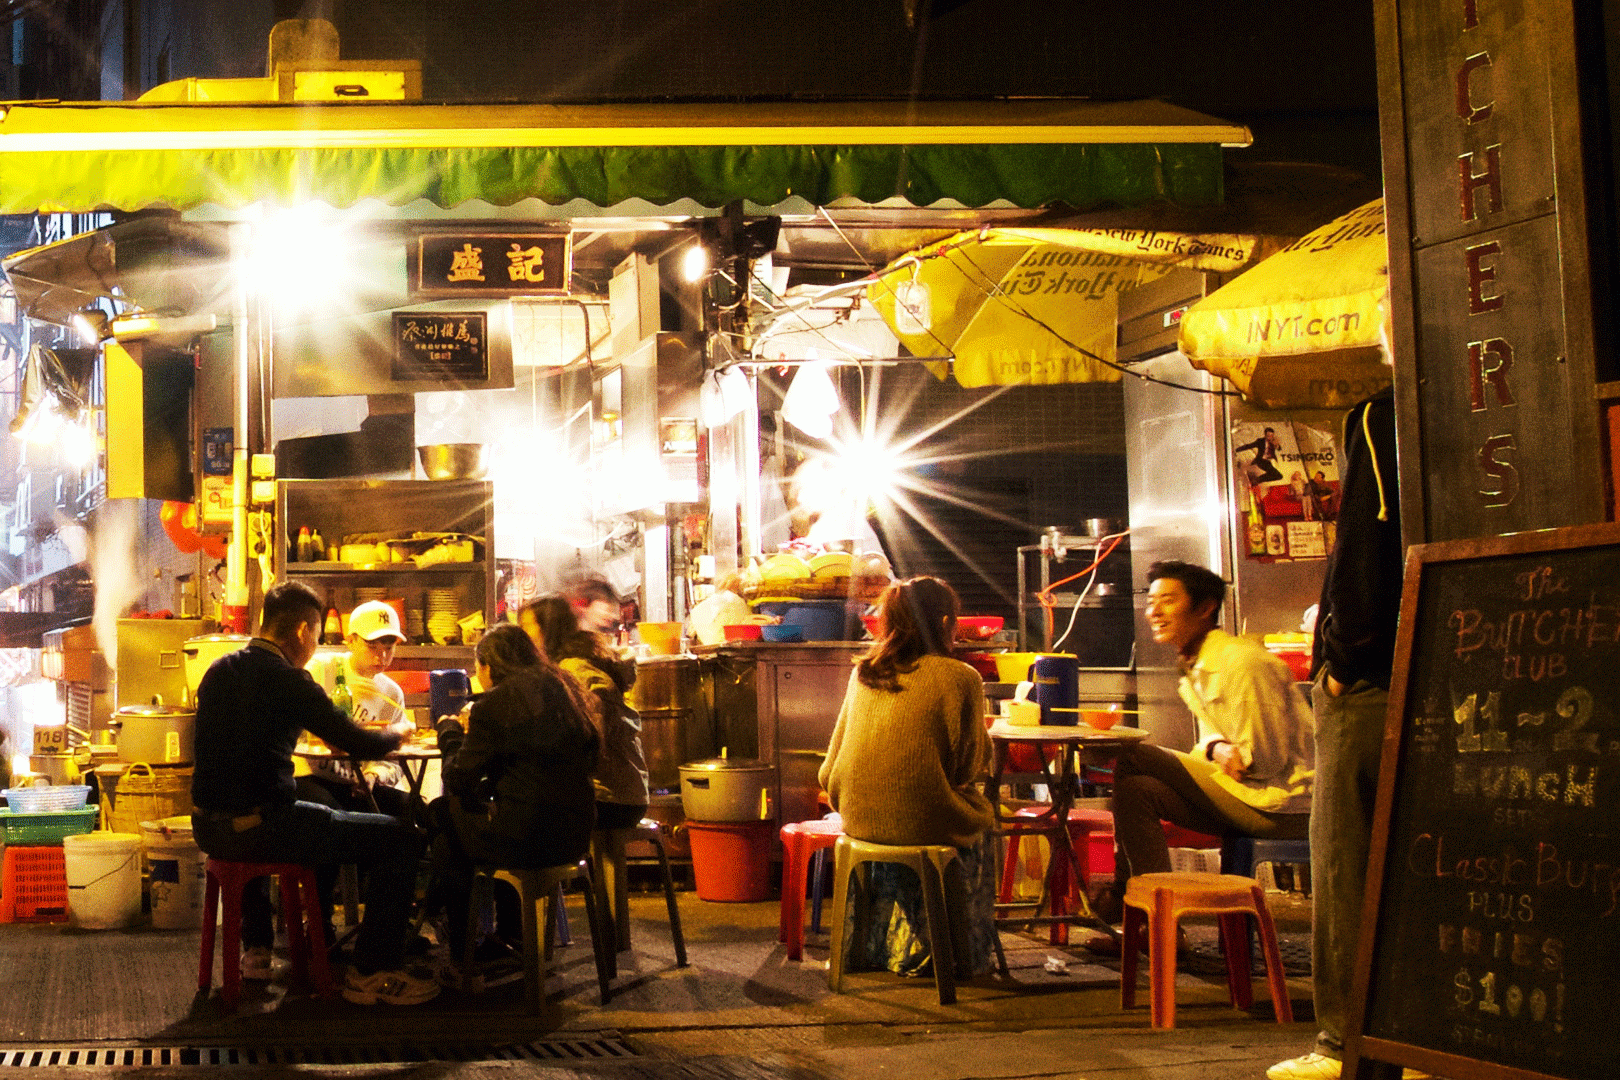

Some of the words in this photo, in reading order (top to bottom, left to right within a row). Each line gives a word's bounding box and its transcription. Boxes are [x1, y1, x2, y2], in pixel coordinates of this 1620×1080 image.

[1136, 229, 1187, 252] York
[447, 243, 545, 282] 盛記
[1247, 311, 1361, 344] INYT.com
[1281, 452, 1334, 462] TSINGTAO
[1515, 566, 1570, 601] The
[1503, 655, 1568, 682] CLUB
[35, 730, 62, 744] 118
[1467, 890, 1534, 922] PLUS
[1438, 923, 1563, 972] FRIES
